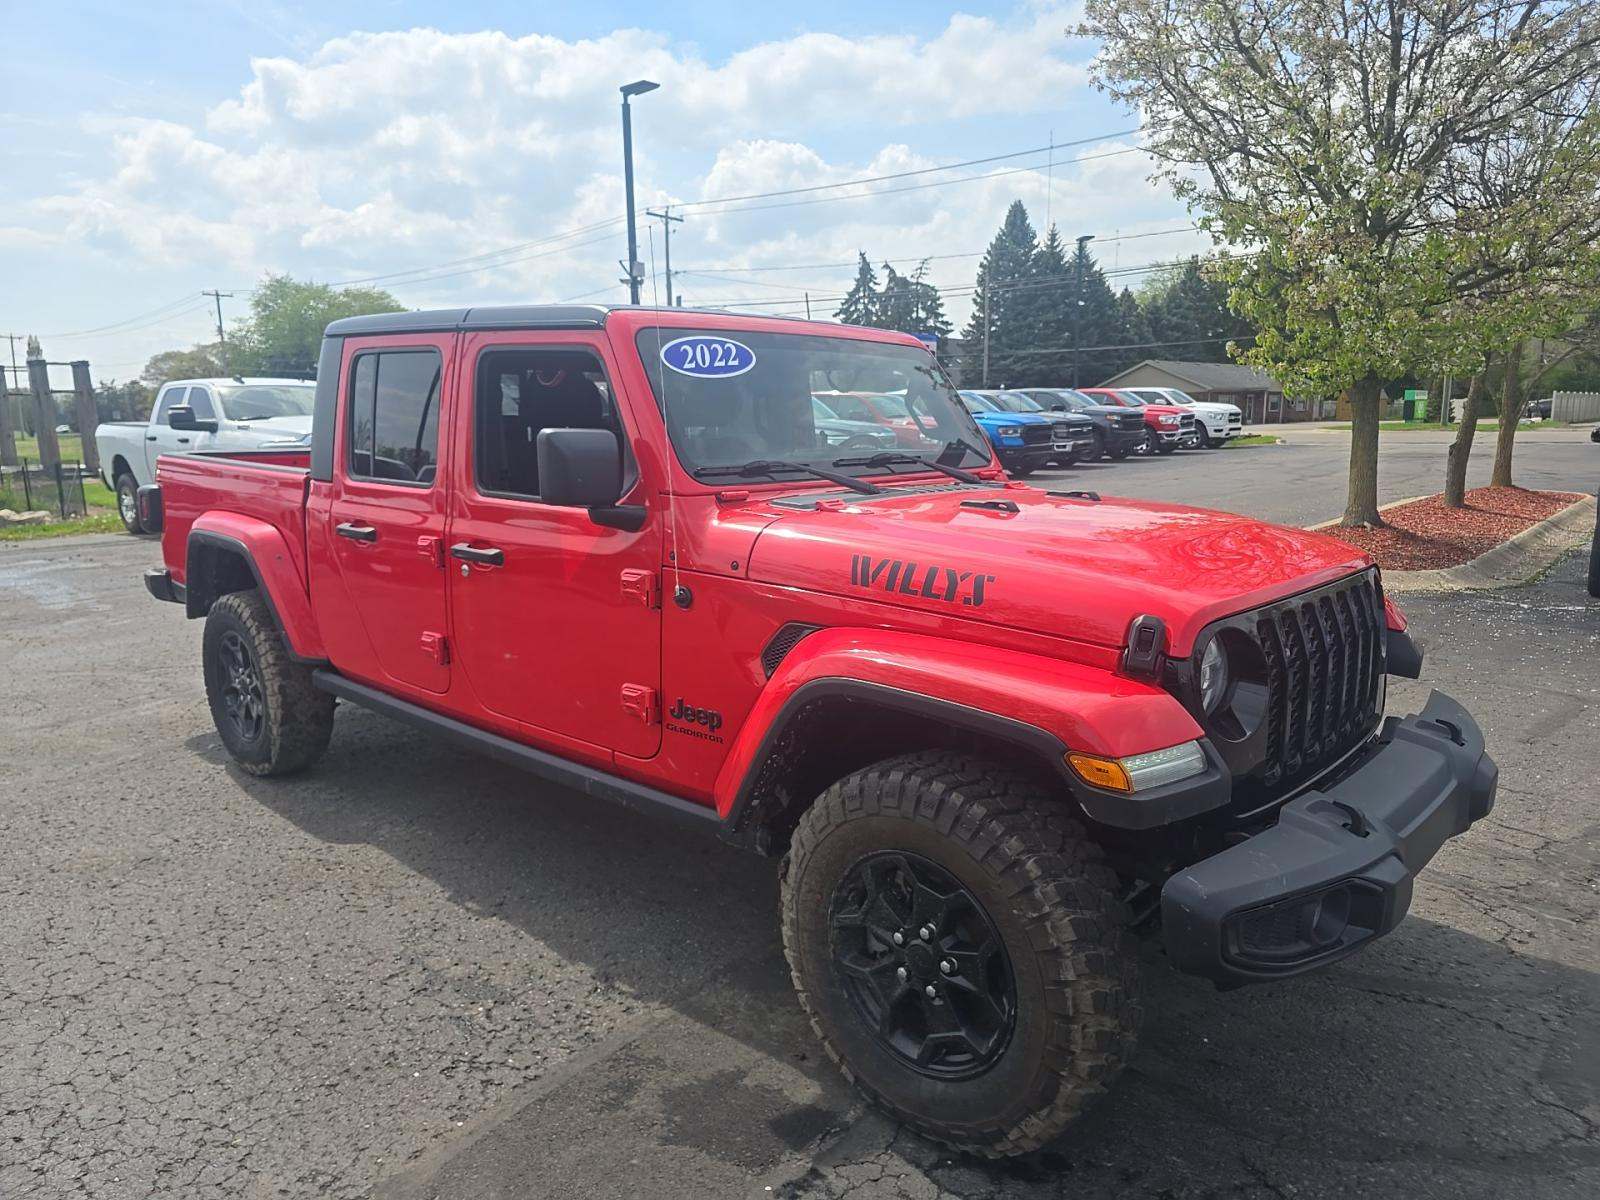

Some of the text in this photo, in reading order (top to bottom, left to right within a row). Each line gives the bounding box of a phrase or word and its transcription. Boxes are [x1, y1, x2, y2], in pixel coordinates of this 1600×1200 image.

[680, 343, 739, 369] 2022
[851, 554, 995, 606] WILLYS
[669, 697, 722, 732] Jeep
[666, 723, 724, 744] GLADIATOR
